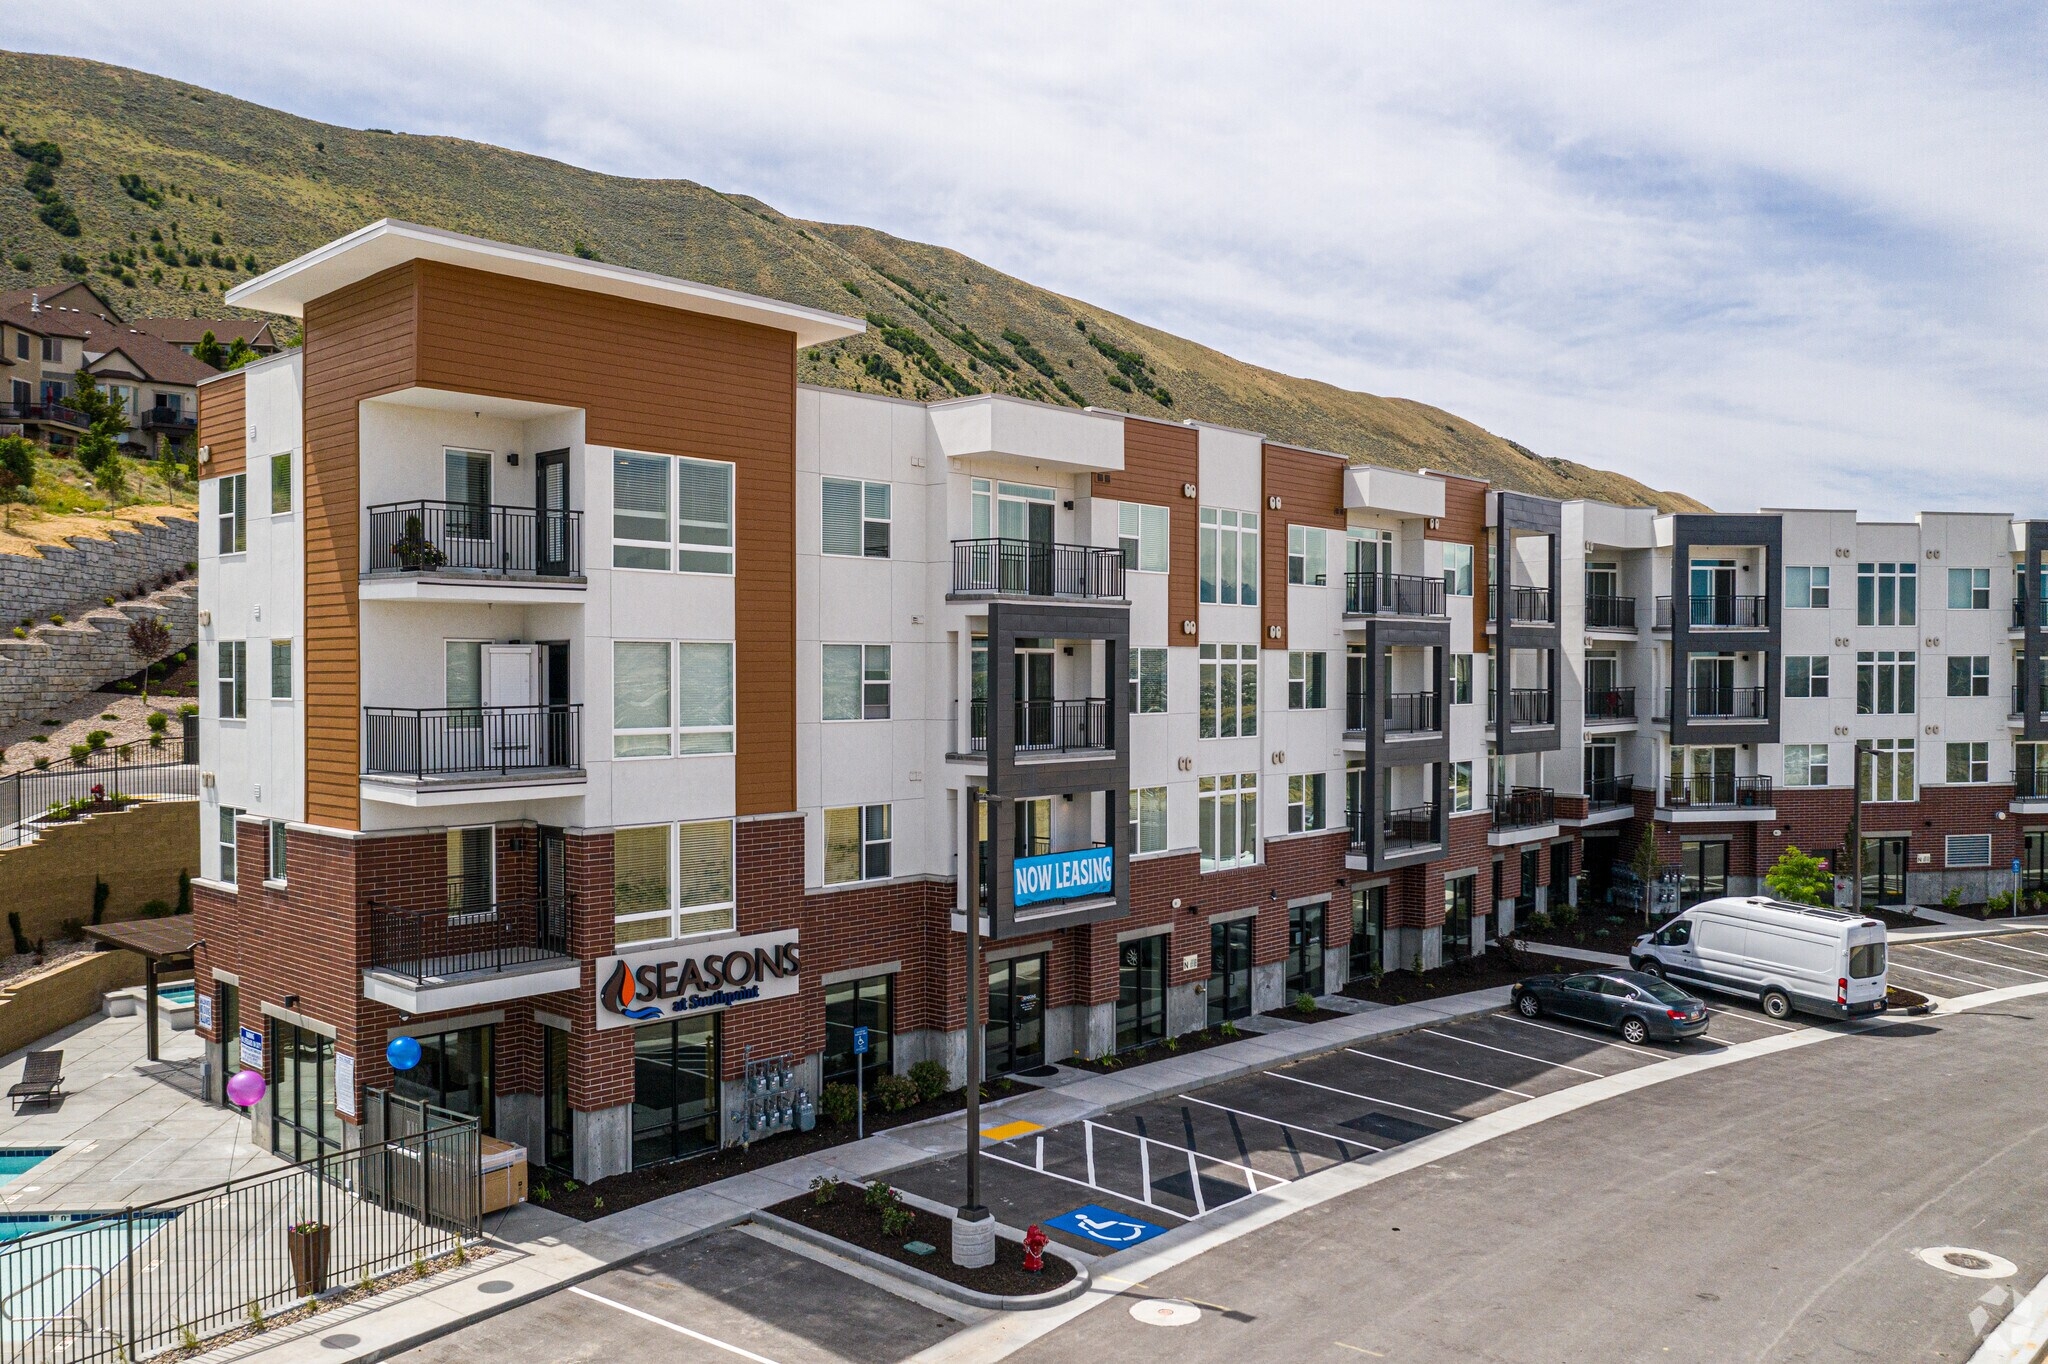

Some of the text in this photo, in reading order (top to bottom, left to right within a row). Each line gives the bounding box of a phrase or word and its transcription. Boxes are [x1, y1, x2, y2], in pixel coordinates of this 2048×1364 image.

[1015, 855, 1112, 895] NOW LEASING
[635, 942, 801, 1003] SEASONS
[672, 985, 760, 1012] at Southpoint
